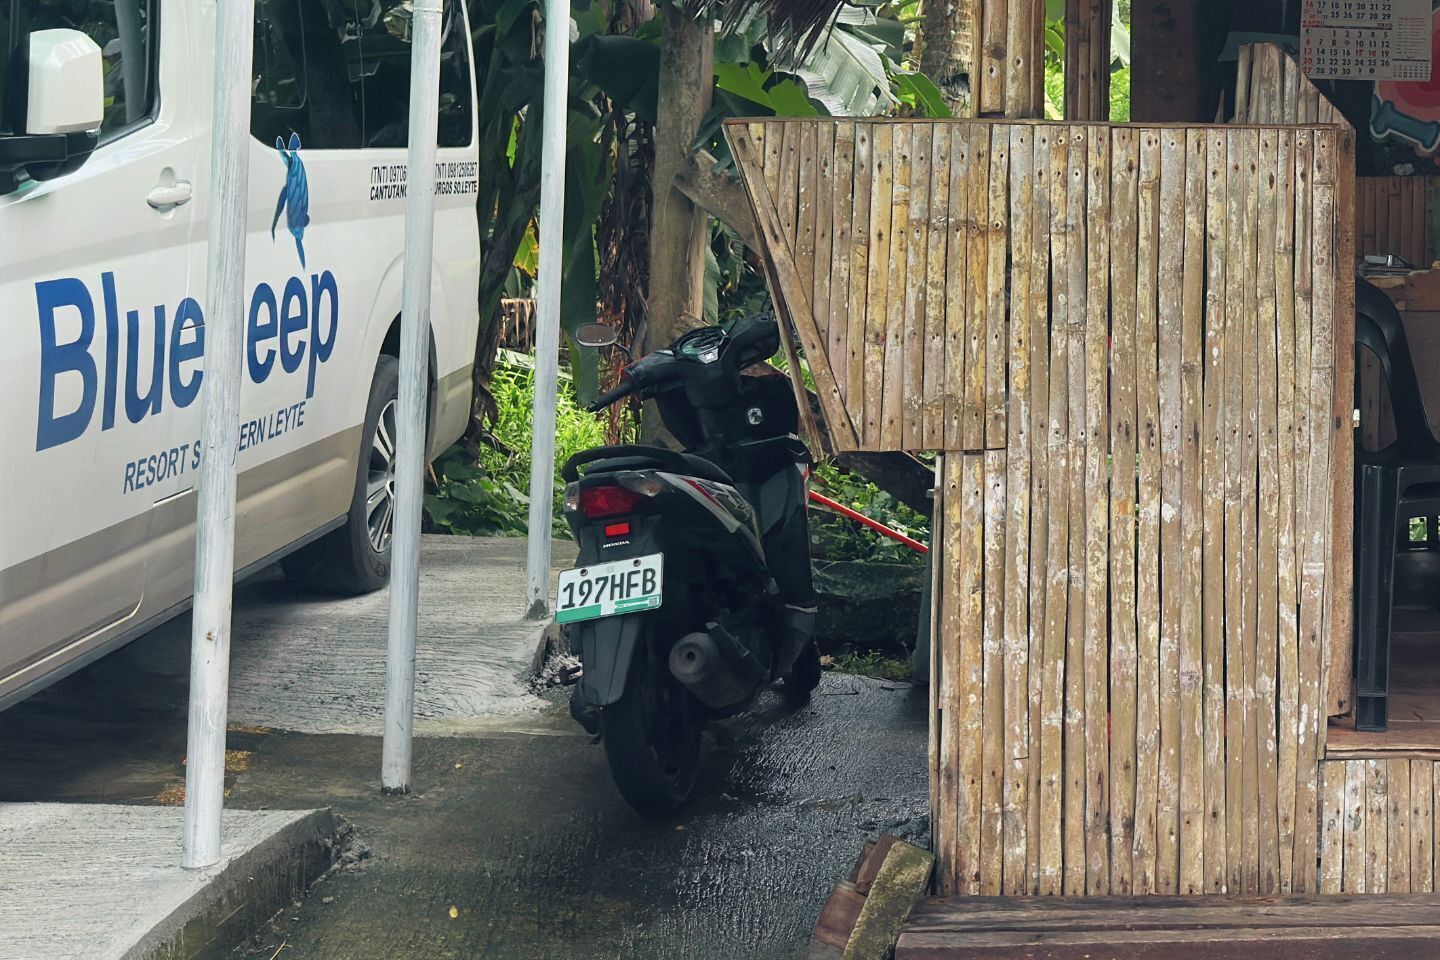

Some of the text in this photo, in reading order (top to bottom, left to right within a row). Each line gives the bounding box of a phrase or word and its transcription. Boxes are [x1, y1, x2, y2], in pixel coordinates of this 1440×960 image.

[1306, 0, 1392, 12] 16 17 18 19 20 21 22
[1330, 10, 1340, 19] 25
[1356, 12, 1366, 20] 27
[1369, 12, 1379, 20] 28
[1381, 13, 1391, 22] 29
[1356, 40, 1364, 48] 10
[1369, 40, 1377, 48] 11
[1380, 40, 1390, 48] 12
[1304, 47, 1390, 58] 13 14 15 16 17 18 19
[1302, 57, 1390, 67] 20 21 22 23 24 25 26
[1315, 66, 1325, 74] 28
[1328, 67, 1339, 76] 29
[1341, 67, 1351, 75] 30
[35, 269, 339, 452] Blueeep
[123, 443, 190, 494] RESORT
[268, 400, 306, 440] LEYTE
[602, 540, 630, 548] HONDA
[561, 567, 656, 610] 197HFB
